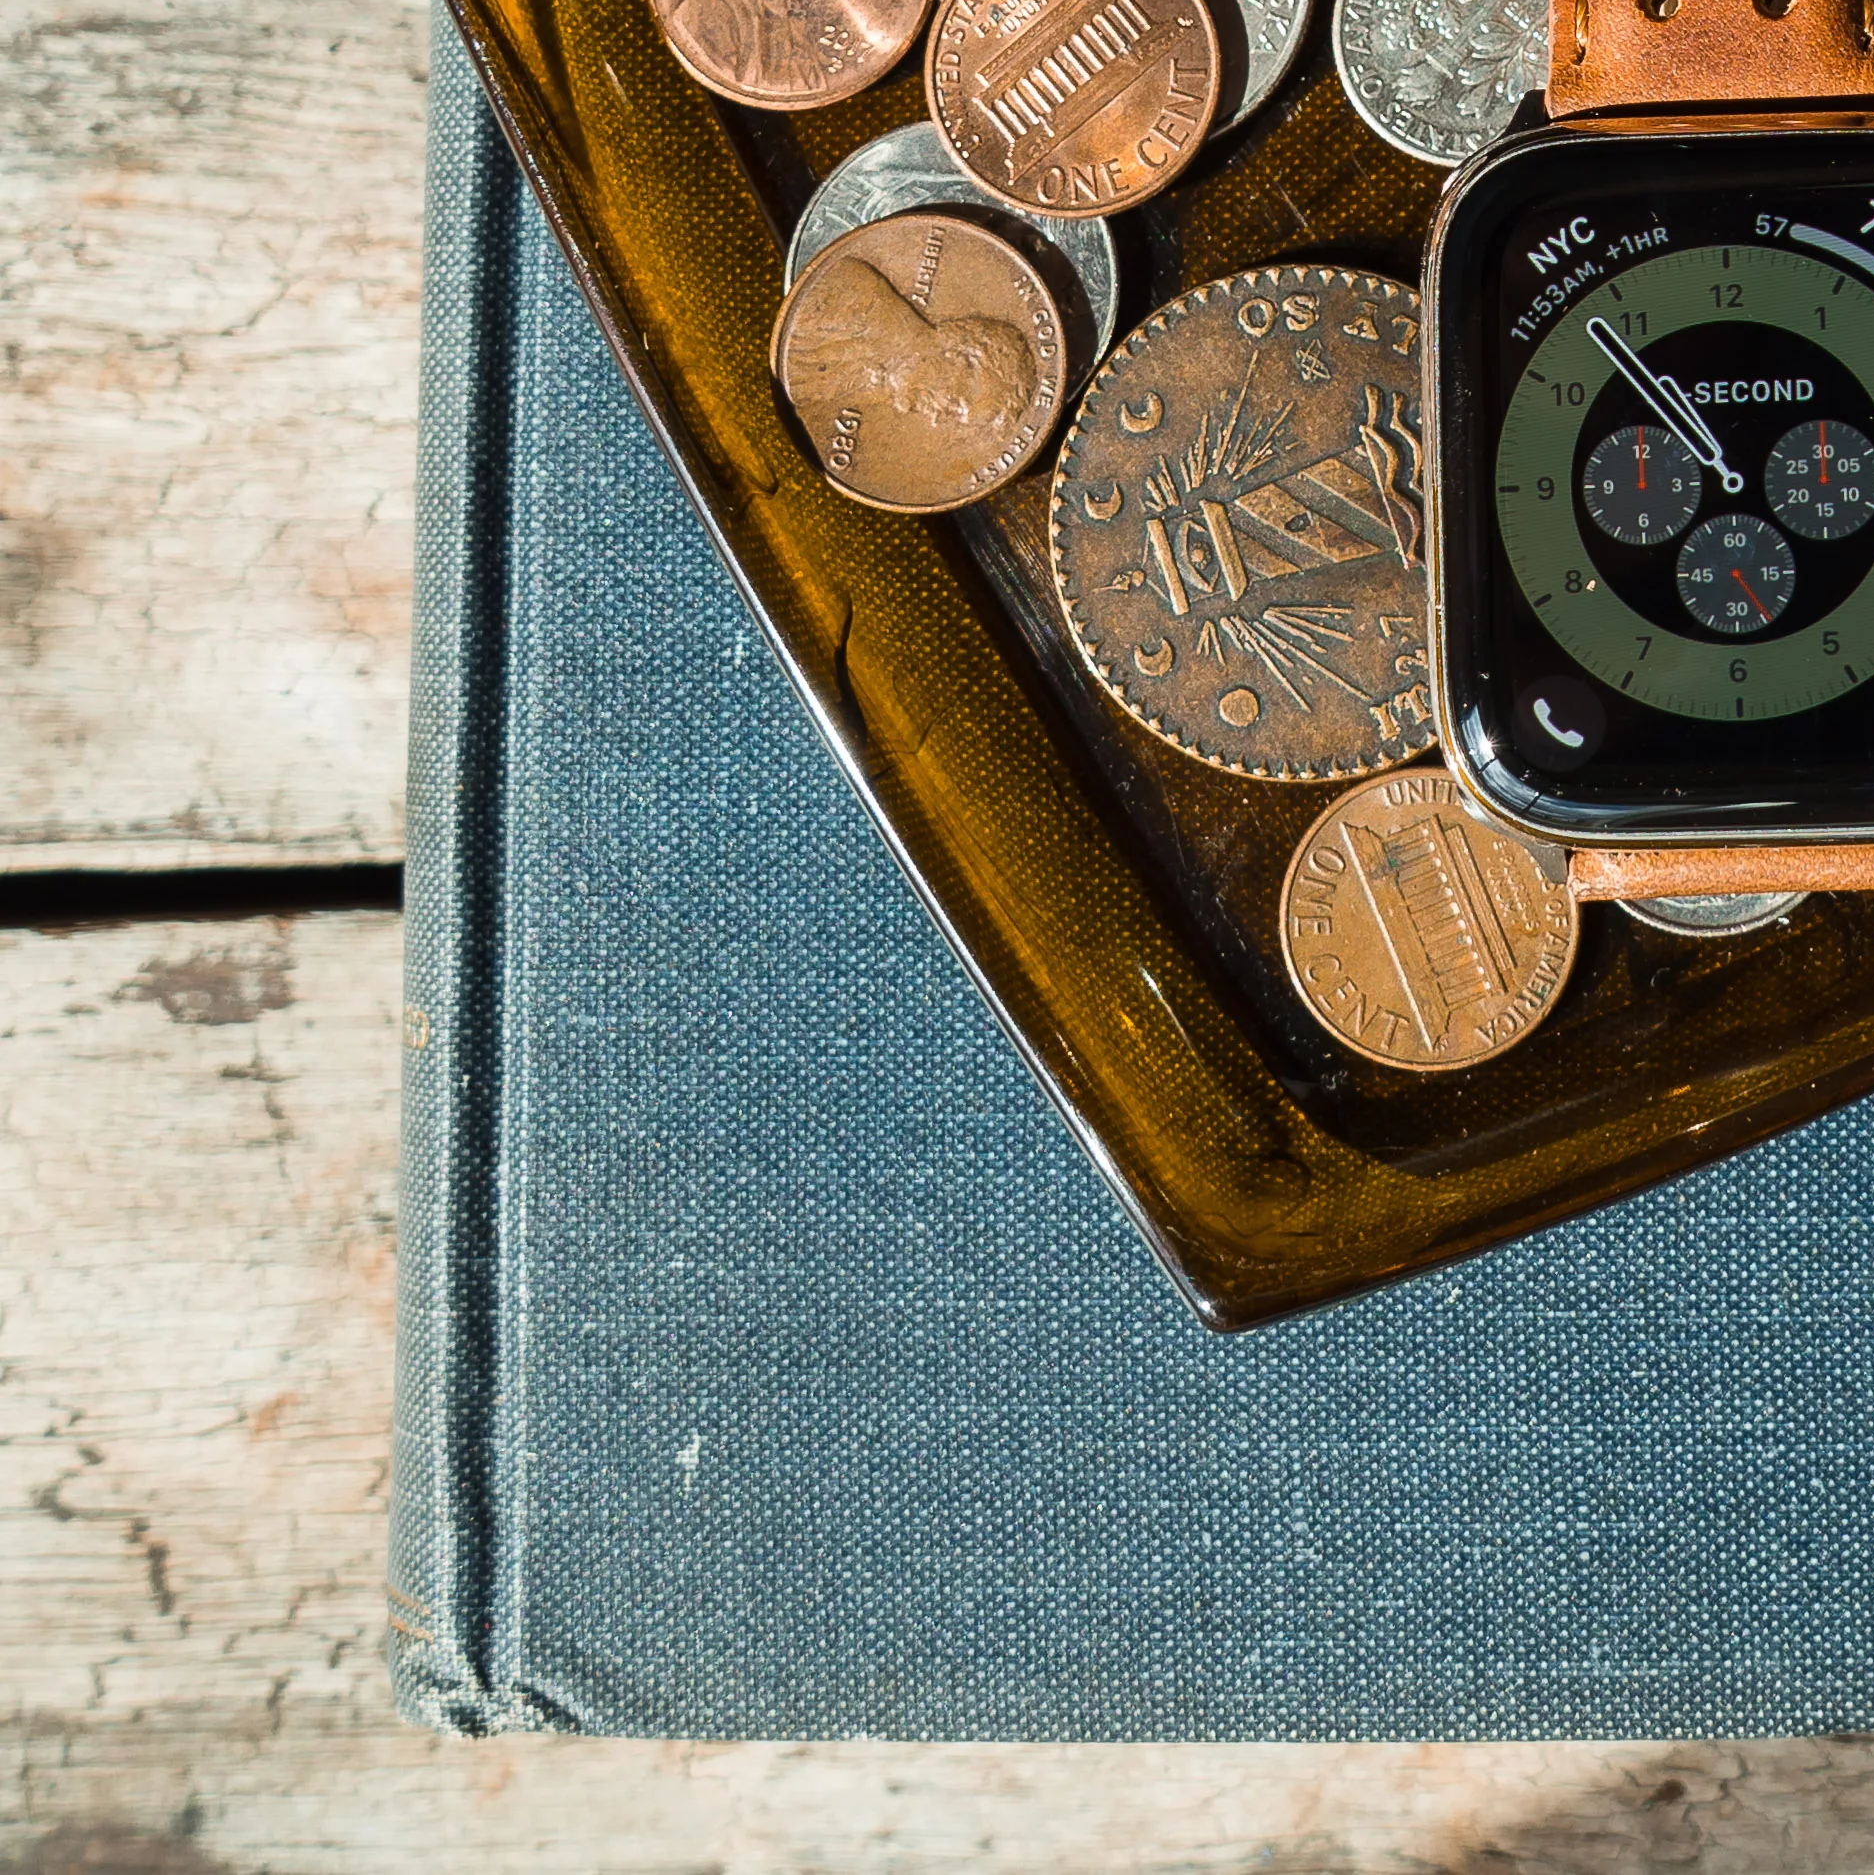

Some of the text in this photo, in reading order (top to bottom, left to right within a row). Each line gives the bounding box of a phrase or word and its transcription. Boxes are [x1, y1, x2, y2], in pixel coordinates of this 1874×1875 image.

[1036, 56, 1209, 206] ONE CENT
[1755, 213, 1789, 238] 57
[1526, 216, 1596, 275] NYC
[910, 225, 946, 308] LIBERTY
[1510, 227, 1669, 342] 11:53AM, +1HR
[1709, 284, 1745, 309] 12
[1619, 311, 1648, 336] 11
[1814, 306, 1827, 331] 1
[1032, 308, 1059, 359] GOD
[1034, 374, 1057, 410] WE
[1551, 382, 1586, 407] 10
[828, 406, 864, 472] 1980
[967, 425, 1039, 492] TRUST
[1632, 444, 1652, 460] 12
[1812, 444, 1835, 460] 30
[1786, 459, 1809, 475] 25
[1837, 458, 1861, 474] 05
[1536, 476, 1555, 501] 9
[1602, 479, 1615, 495] 9
[1671, 477, 1683, 493] 3
[1787, 488, 1810, 504] 20
[1840, 487, 1860, 503] 10
[1637, 513, 1650, 528] 6
[1815, 502, 1835, 518] 15
[1723, 532, 1747, 548] 60
[1564, 569, 1583, 595] 8
[1690, 568, 1714, 584] 45
[1760, 566, 1780, 582] 15
[1726, 601, 1749, 617] 30
[1635, 636, 1653, 661] 7
[1821, 630, 1840, 656] 5
[1729, 658, 1748, 683] 6
[1293, 845, 1410, 1051] ONE CENT
[1472, 931, 1570, 1048] AMERICA
